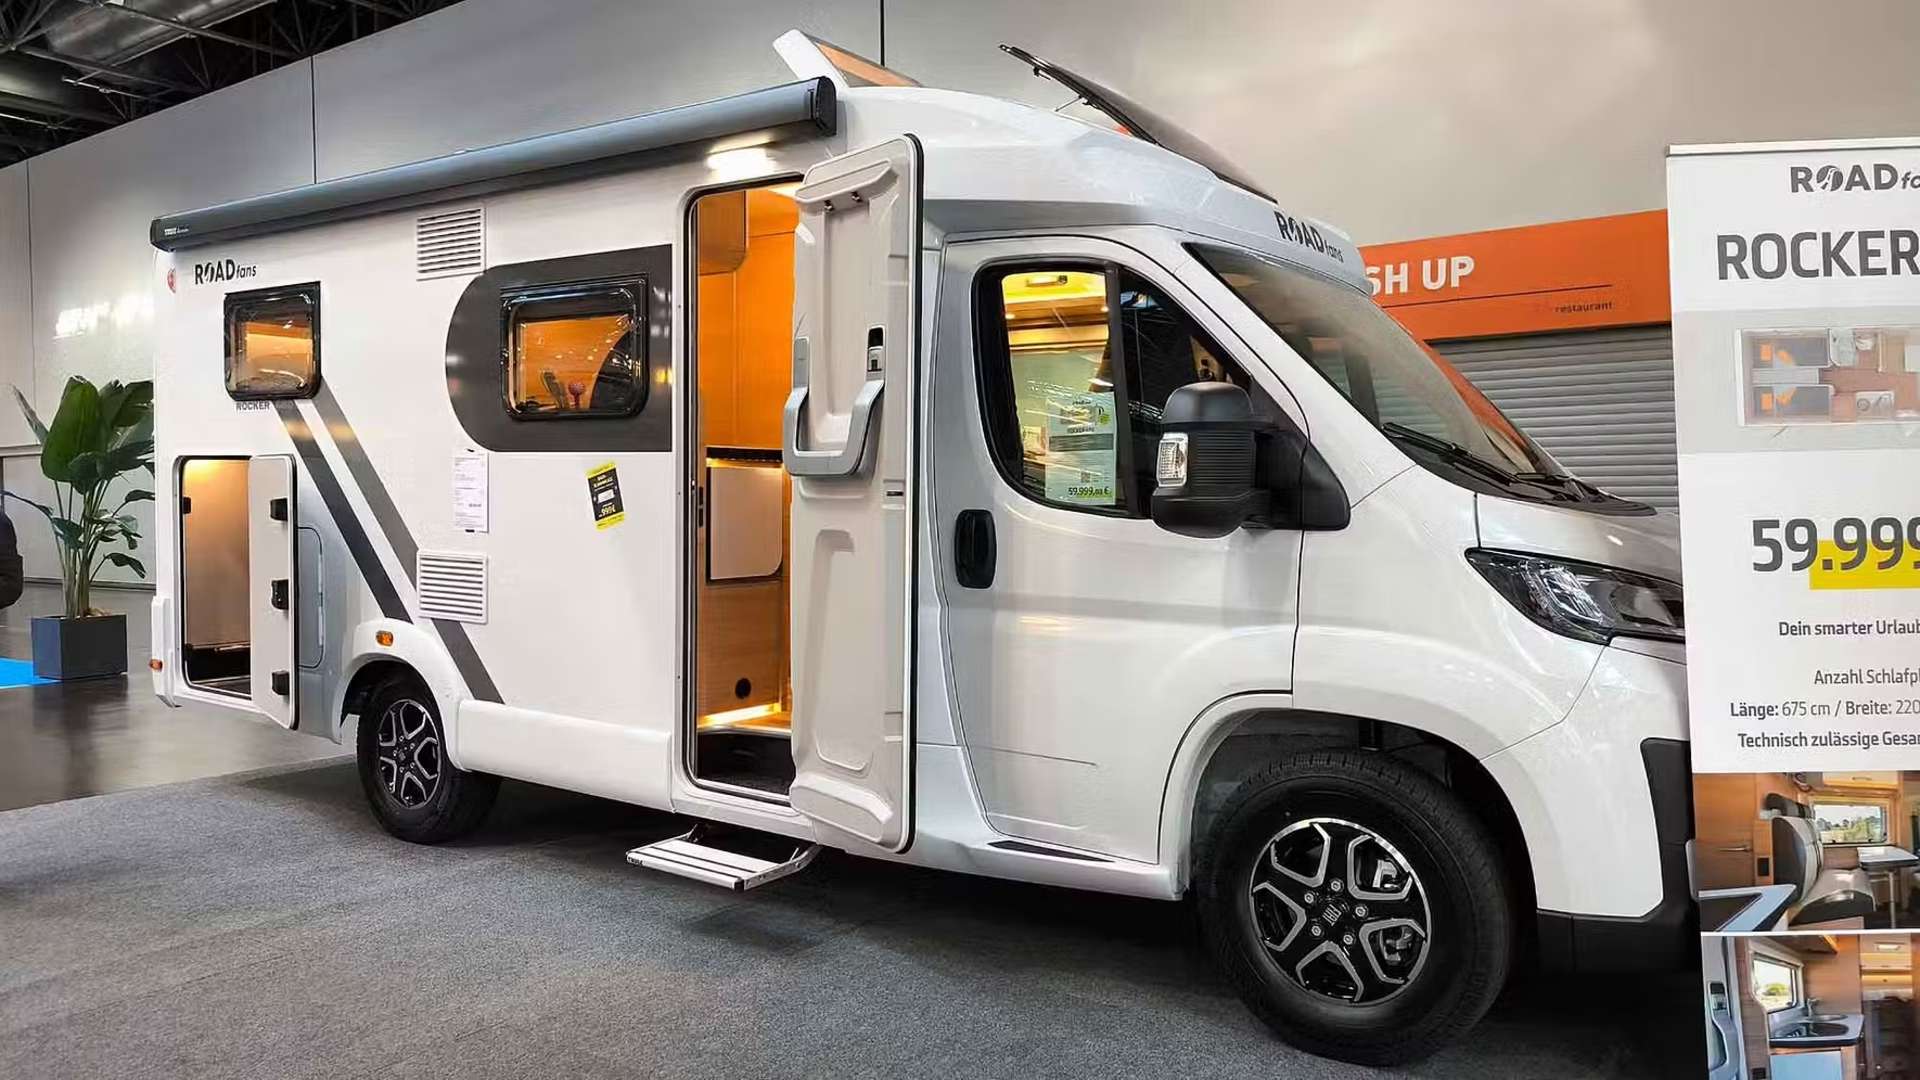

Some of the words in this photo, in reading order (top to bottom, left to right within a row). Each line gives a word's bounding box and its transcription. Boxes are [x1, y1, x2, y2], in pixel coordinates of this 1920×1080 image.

[1717, 230, 1920, 280] ROCKER
[1422, 256, 1475, 291] UP
[1555, 302, 1612, 313] restaurant
[236, 400, 270, 411] ROCKER
[1779, 620, 1811, 636] Dein
[1815, 621, 1873, 635] smarter
[1814, 668, 1864, 684] Anzahl
[1730, 702, 1779, 720] Länge:
[1782, 701, 1807, 716] 675
[1810, 703, 1831, 716] cm
[1834, 700, 1842, 717] /
[1845, 700, 1892, 716] Breite:
[1895, 699, 1920, 715] 220
[1737, 732, 1808, 748] Technisch
[1811, 731, 1879, 750] zulässige
